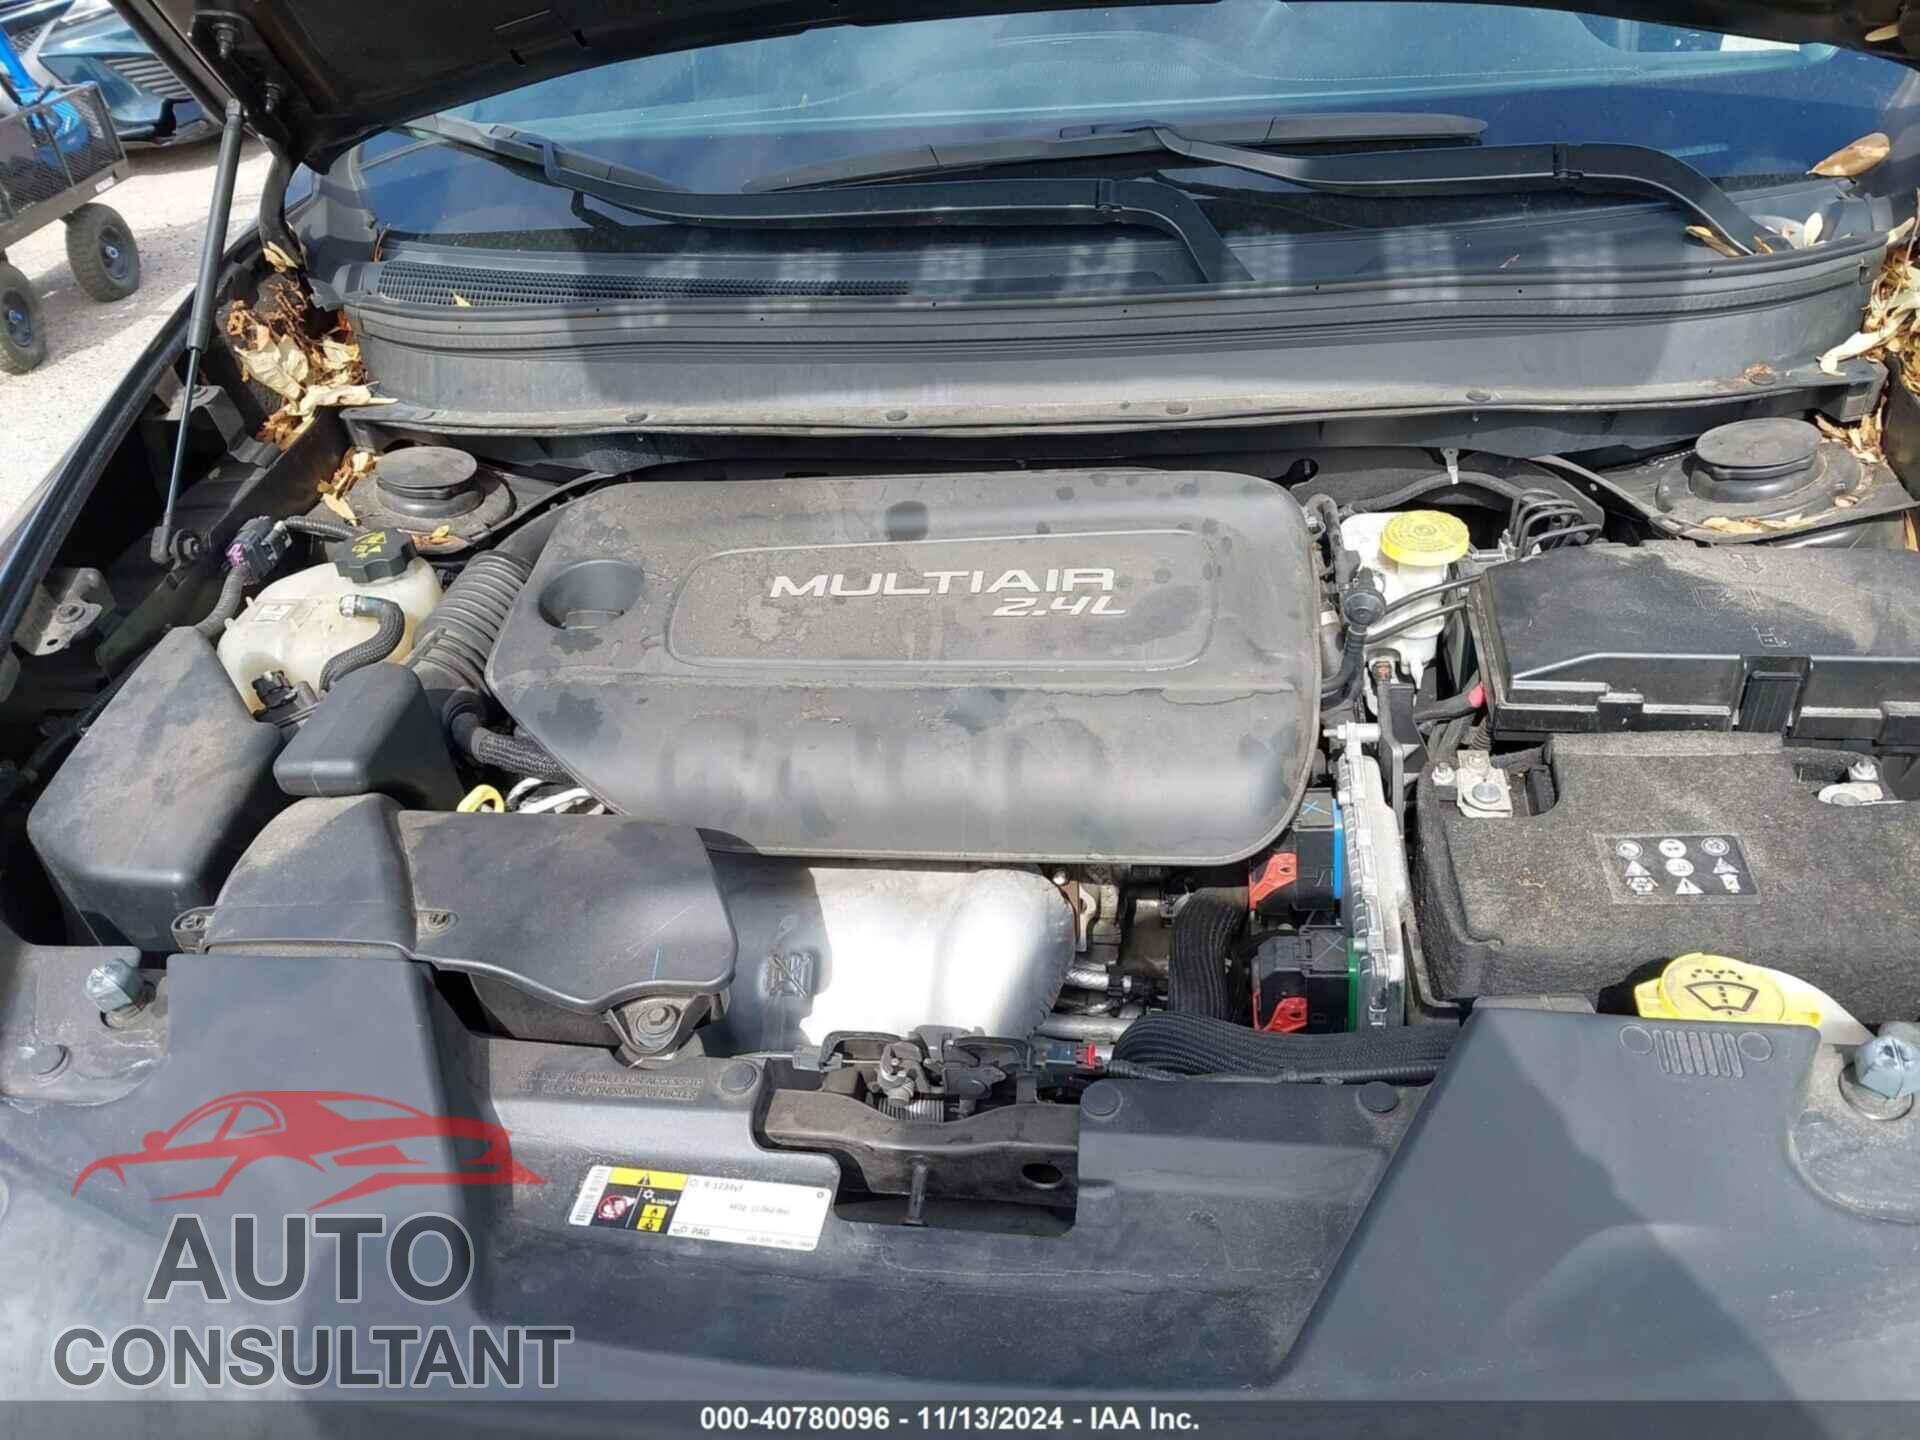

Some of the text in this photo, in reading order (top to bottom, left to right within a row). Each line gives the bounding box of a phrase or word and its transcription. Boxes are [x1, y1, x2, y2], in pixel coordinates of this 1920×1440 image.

[769, 568, 1115, 598] MULTIAIR
[992, 596, 1127, 618] 2.4L
[691, 1226, 711, 1237] PAG
